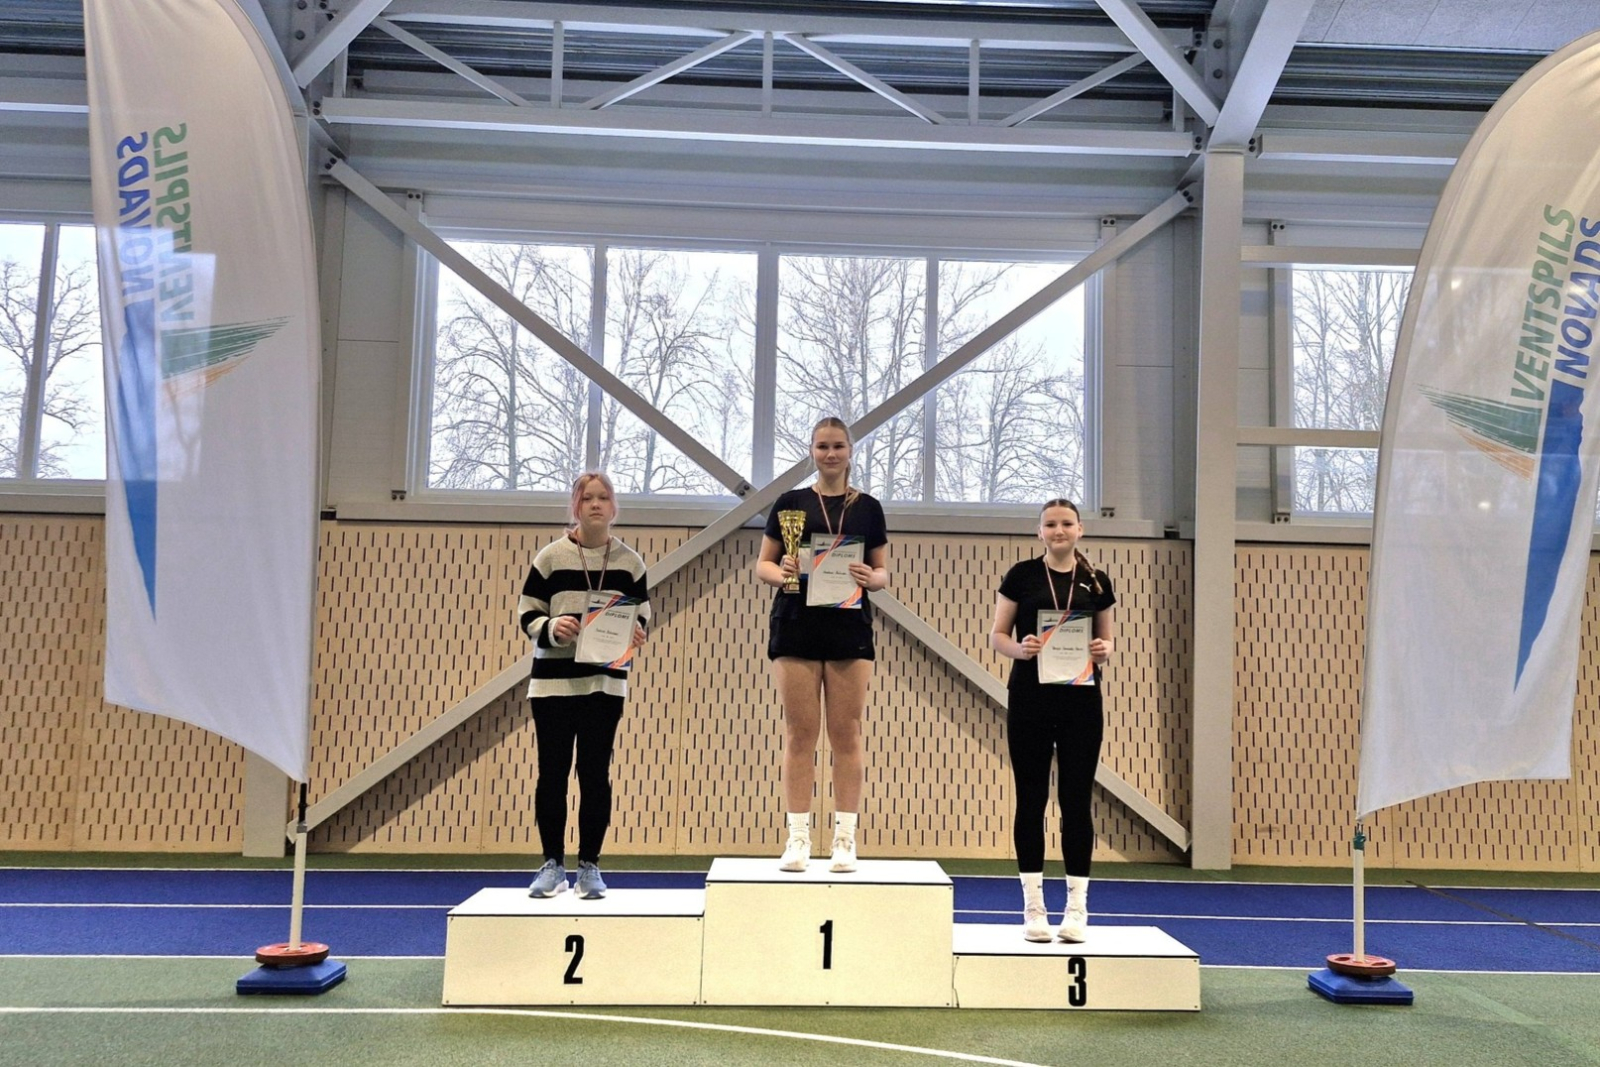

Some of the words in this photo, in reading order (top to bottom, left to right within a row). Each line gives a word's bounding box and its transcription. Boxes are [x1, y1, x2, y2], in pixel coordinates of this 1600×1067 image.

[1511, 204, 1576, 401] VENTSPILS
[1554, 217, 1600, 379] NOVADS
[563, 934, 585, 985] 2
[819, 919, 833, 970] 1
[1067, 956, 1087, 1007] 3
